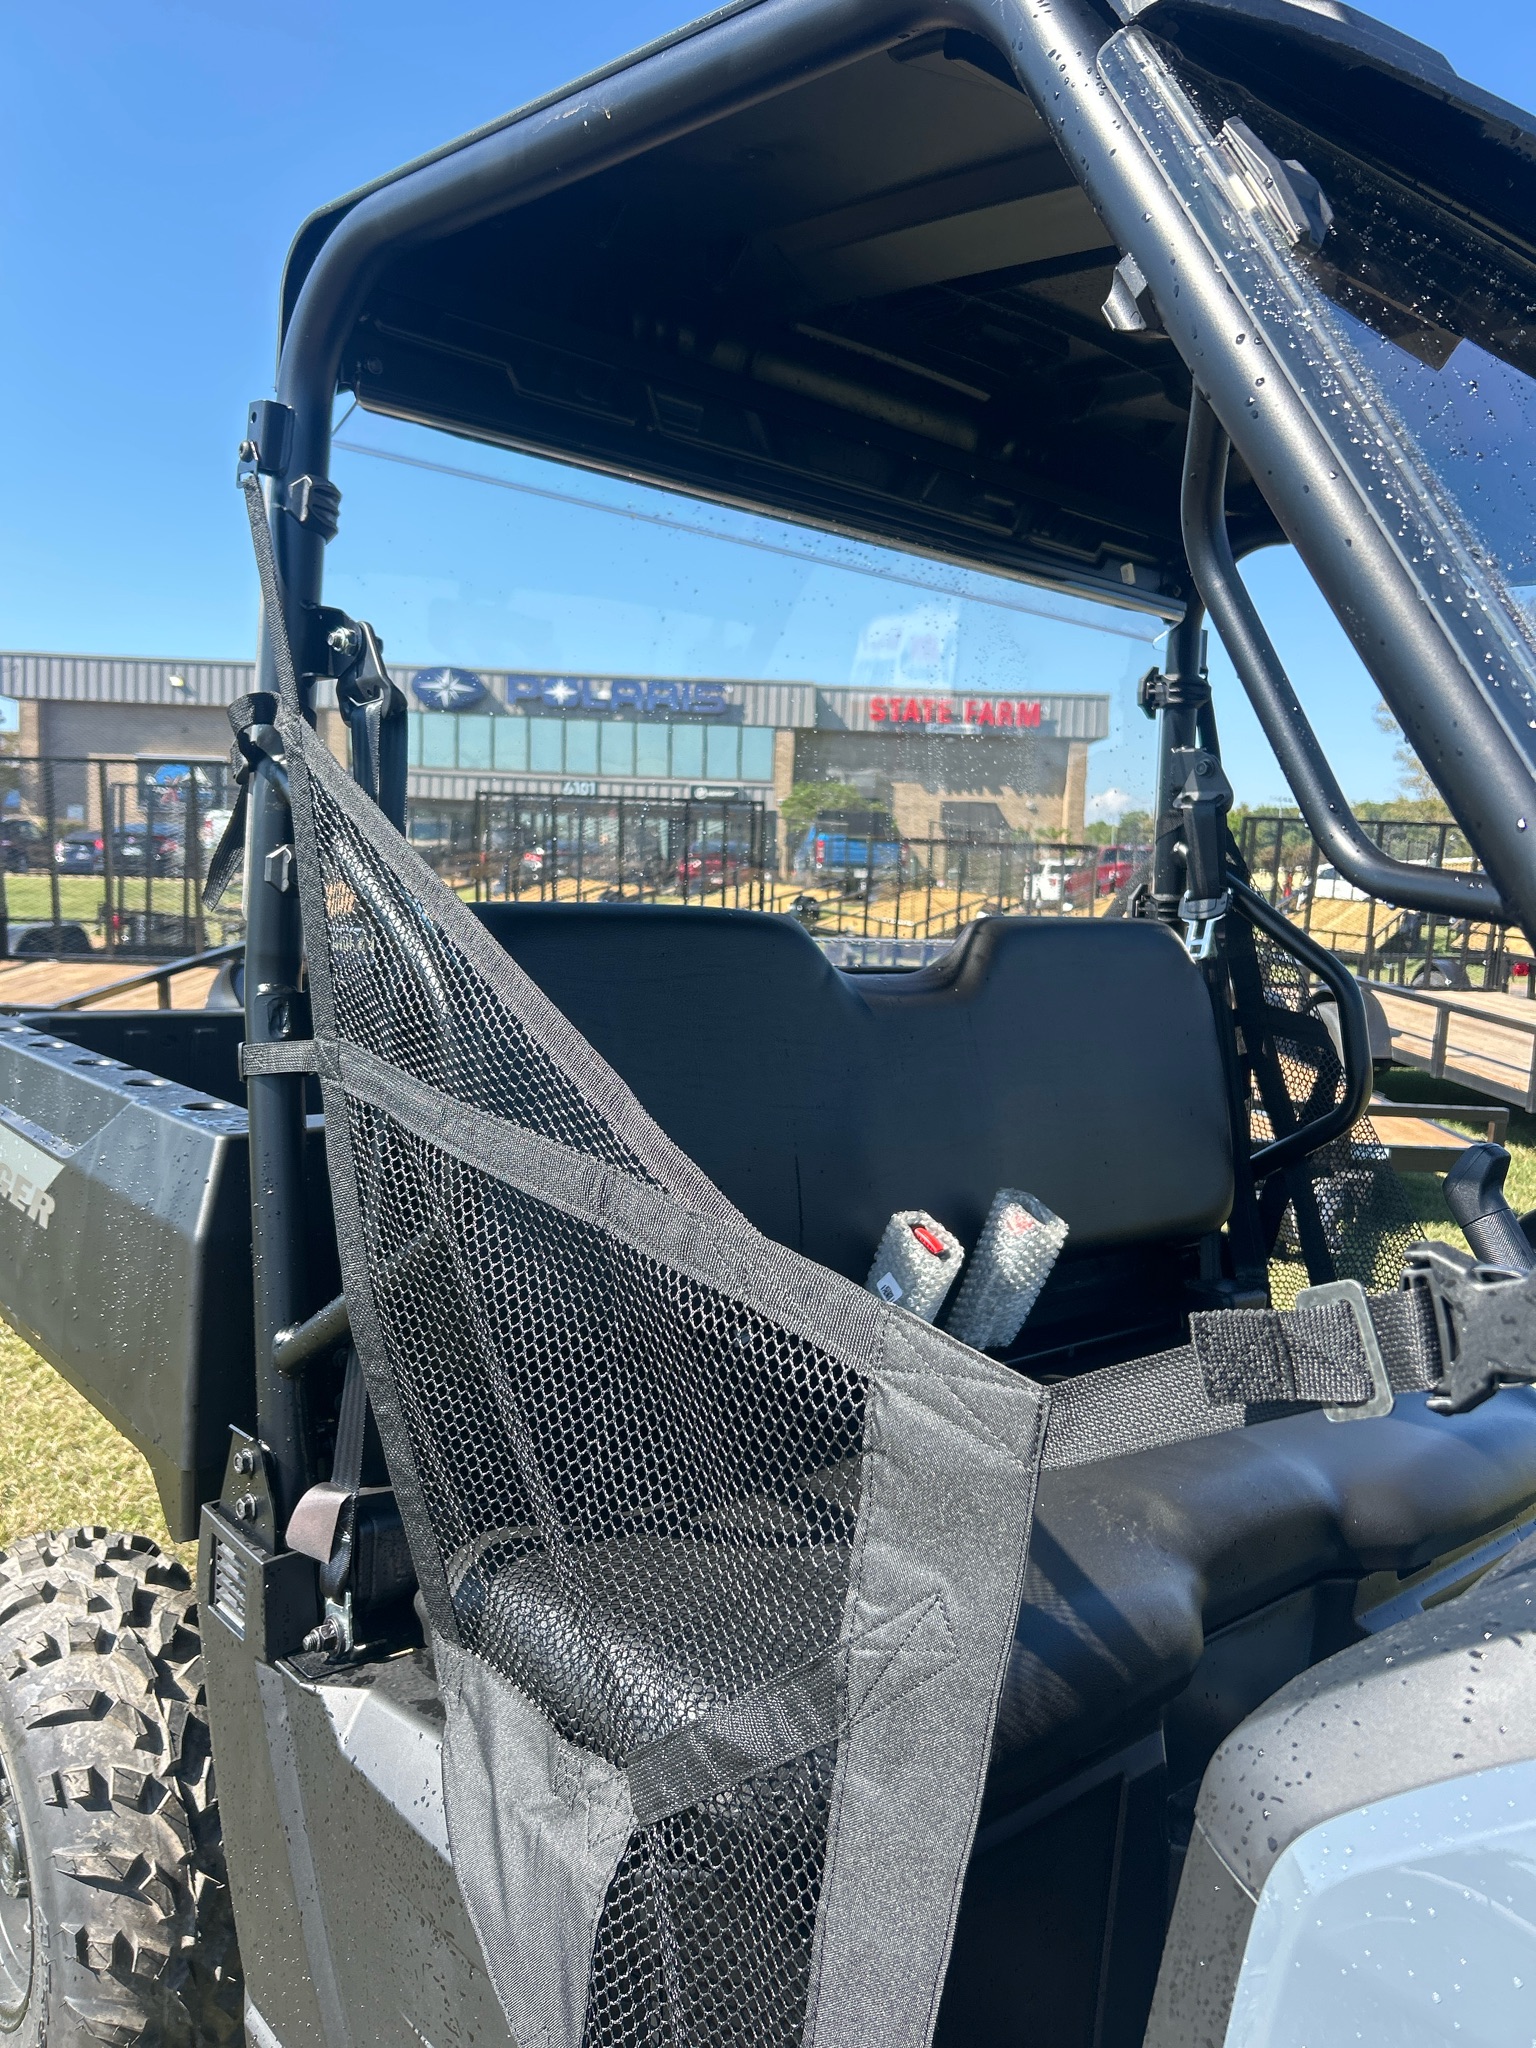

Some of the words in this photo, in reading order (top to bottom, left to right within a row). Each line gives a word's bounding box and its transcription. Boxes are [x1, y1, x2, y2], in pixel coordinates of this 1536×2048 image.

[507, 675, 727, 714] POLARIS
[870, 696, 952, 724] STATE
[964, 700, 1041, 728] FARM
